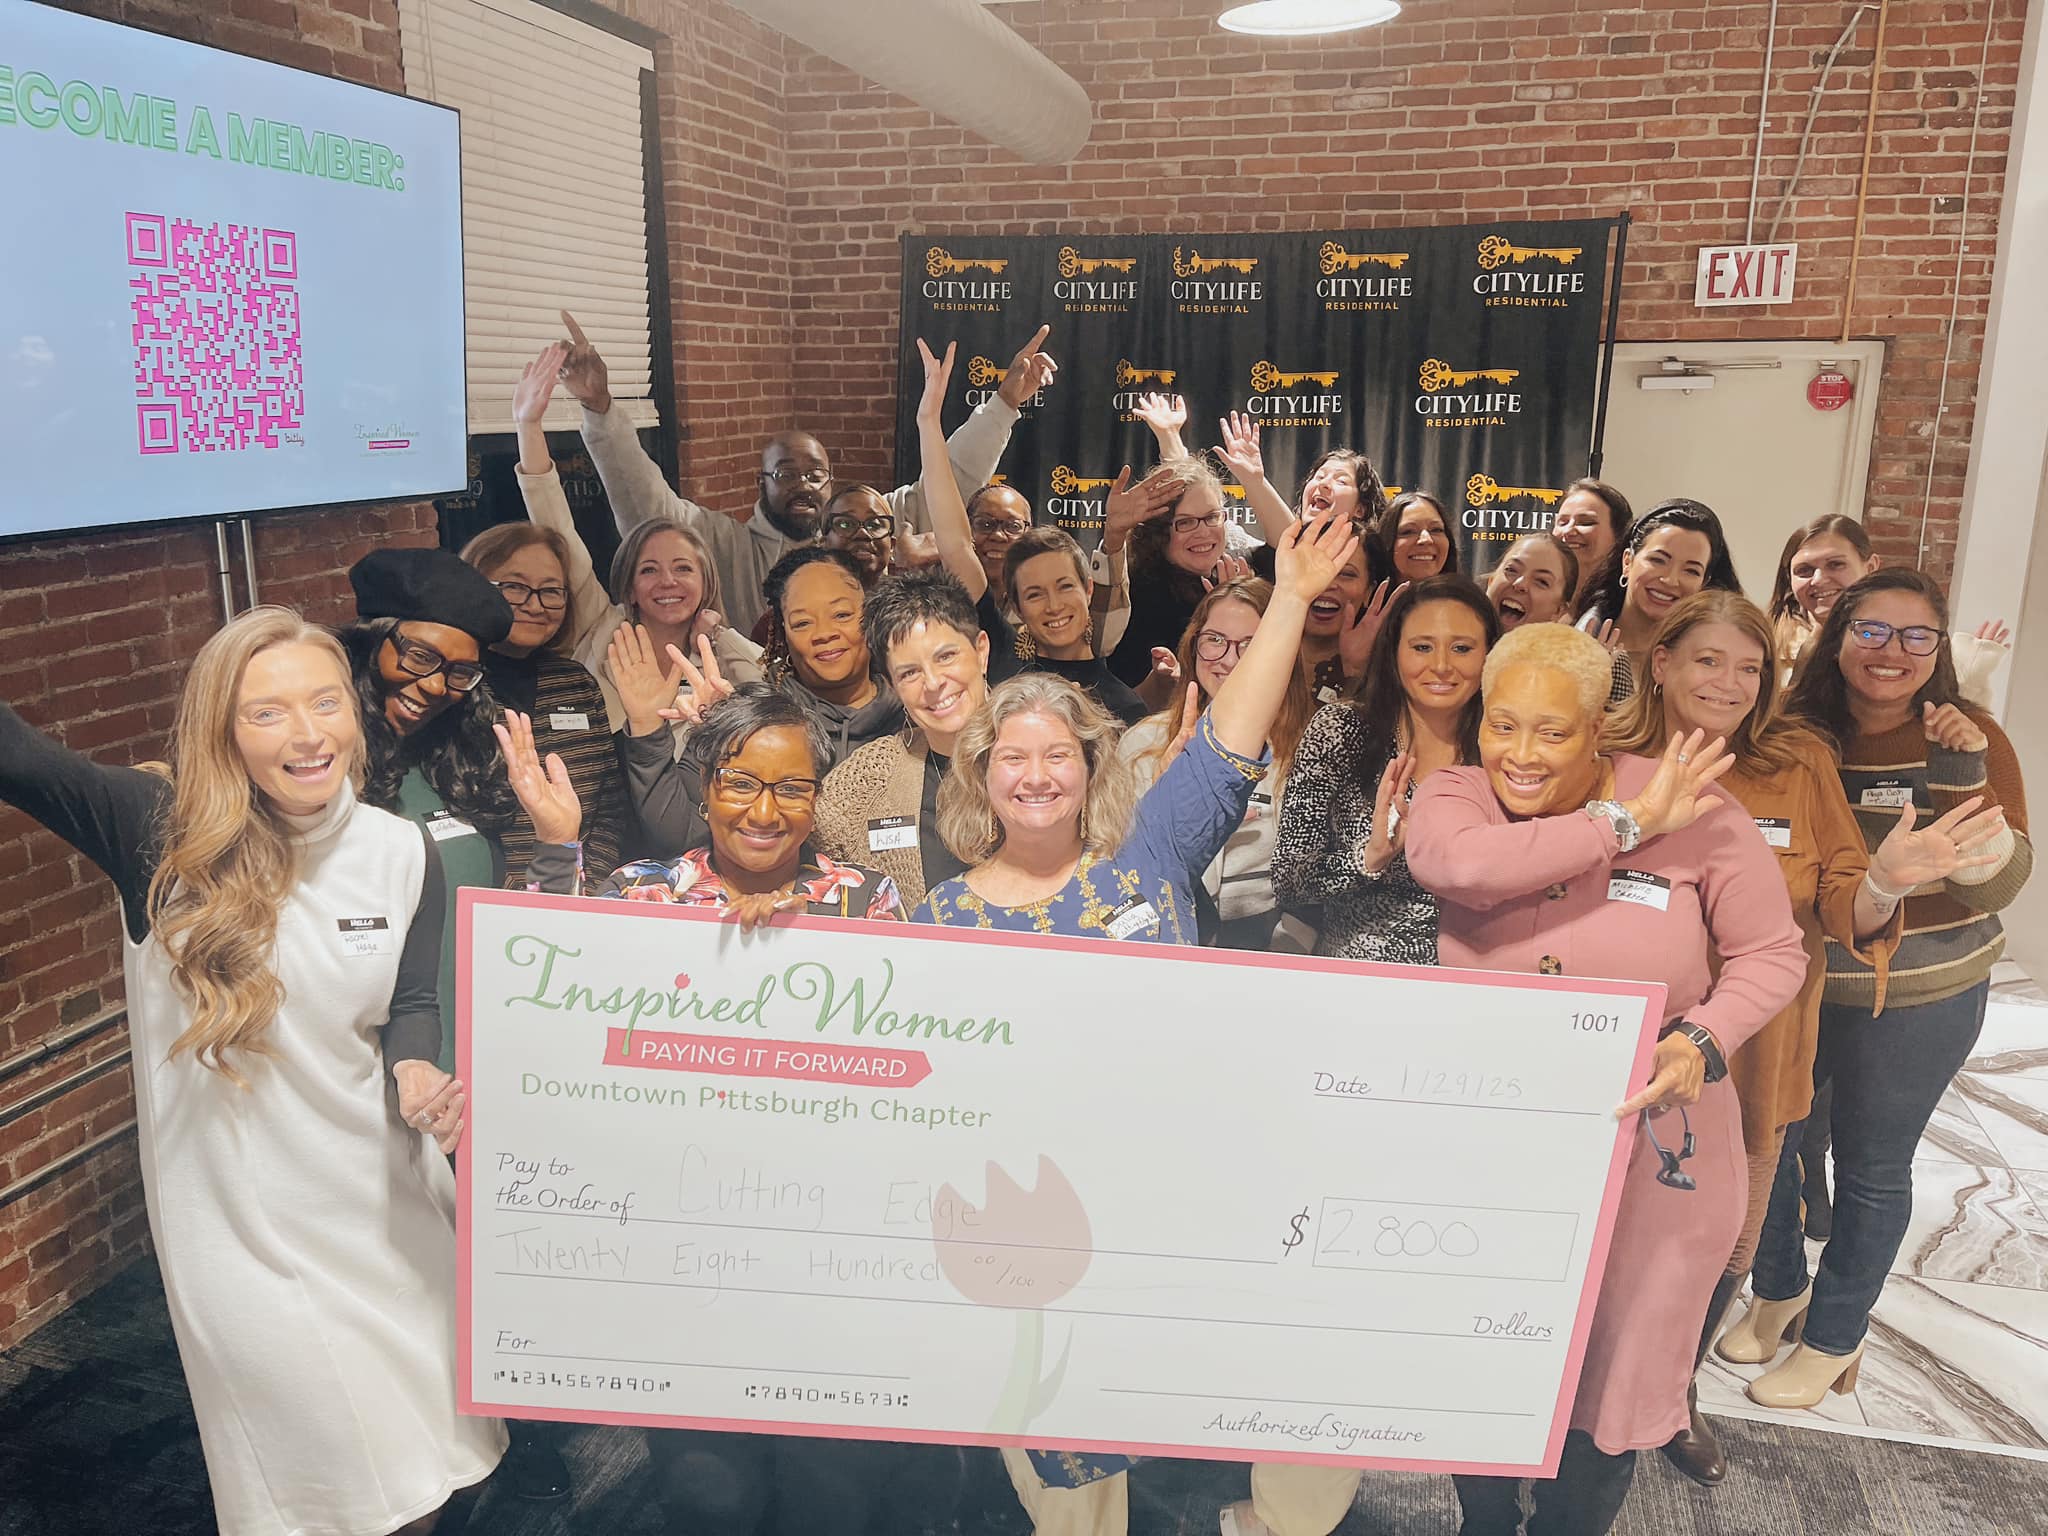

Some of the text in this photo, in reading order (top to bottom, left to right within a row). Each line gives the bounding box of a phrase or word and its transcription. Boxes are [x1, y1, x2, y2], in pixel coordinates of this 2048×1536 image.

[0, 65, 406, 192] ECOME A MEMBER:
[1473, 272, 1584, 294] CITYLIFE
[1706, 249, 1790, 299] EXIT
[923, 281, 1012, 300] CITYLIFE
[1053, 281, 1137, 299] CITYLIFE
[1171, 280, 1263, 300] CITYLIFE
[1316, 277, 1412, 297] CITYLIFE
[933, 302, 1001, 312] RESIDENTIAL
[1325, 302, 1399, 311] RESIDENTIAL
[1485, 296, 1569, 308] RESIDENTIAL
[1247, 394, 1343, 415] CITYLIFE
[1414, 393, 1522, 414] CITYLIFE
[1258, 417, 1332, 427] RESIDENTIAL
[1426, 416, 1506, 427] RESIDENTIAL
[1047, 497, 1107, 517] CITYL
[880, 817, 903, 826] HELLO
[1627, 870, 1655, 881] HELLO
[350, 919, 375, 927] HELLO
[504, 935, 1015, 1056] Inspired Women
[1570, 1013, 1619, 1033] 1001
[641, 1041, 908, 1079] PAYING IT FORWARD
[1314, 1072, 1372, 1095] Date
[1400, 1064, 1522, 1099] 1/29/25
[521, 1073, 992, 1130] Downtown Pittsburgh Chapter
[496, 1152, 575, 1185] Pay to
[679, 1143, 983, 1239] Cutting Edge
[496, 1179, 636, 1225] the Order of
[1282, 1205, 1310, 1257] $
[496, 1227, 631, 1277] Twenty
[672, 1242, 761, 1308] Eight
[808, 1249, 941, 1282] Hundred
[1473, 1311, 1553, 1338] Dollars
[496, 1331, 537, 1349] For
[1203, 1412, 1427, 1450] Authorized Signature
